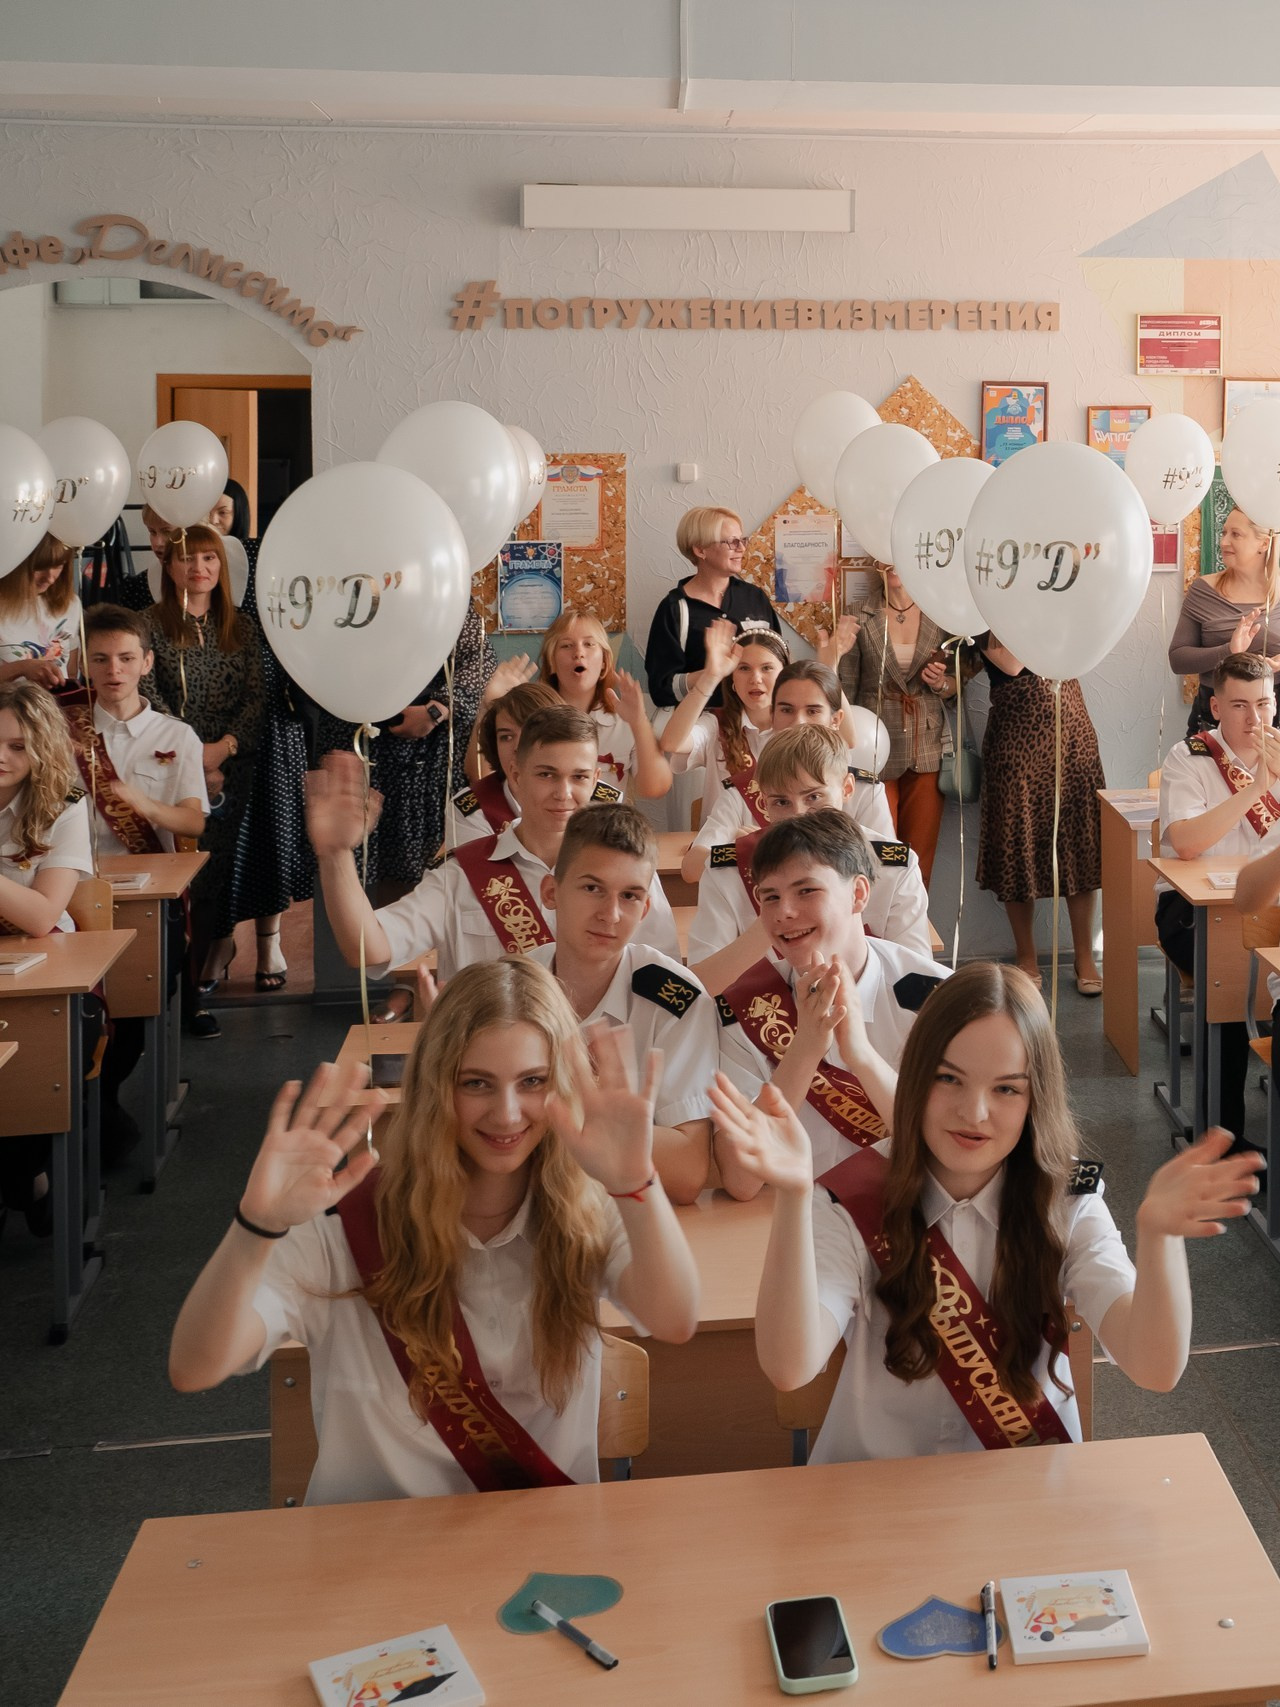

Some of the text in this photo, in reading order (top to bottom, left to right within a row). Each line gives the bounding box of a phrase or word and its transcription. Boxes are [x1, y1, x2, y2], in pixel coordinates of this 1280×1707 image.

[449, 279, 1061, 331] #ПОГРУЖЕНИЕВИЗМЕРЕНИЯ
[783, 541, 828, 549] БЛАГОДАРНОСТЬ
[509, 560, 553, 570] ГРАМОТА
[975, 538, 1102, 592] #9"D"
[267, 570, 402, 631] #9"D"
[657, 978, 682, 1001] КК
[669, 986, 694, 1011] 33
[1075, 1164, 1099, 1187] 33
